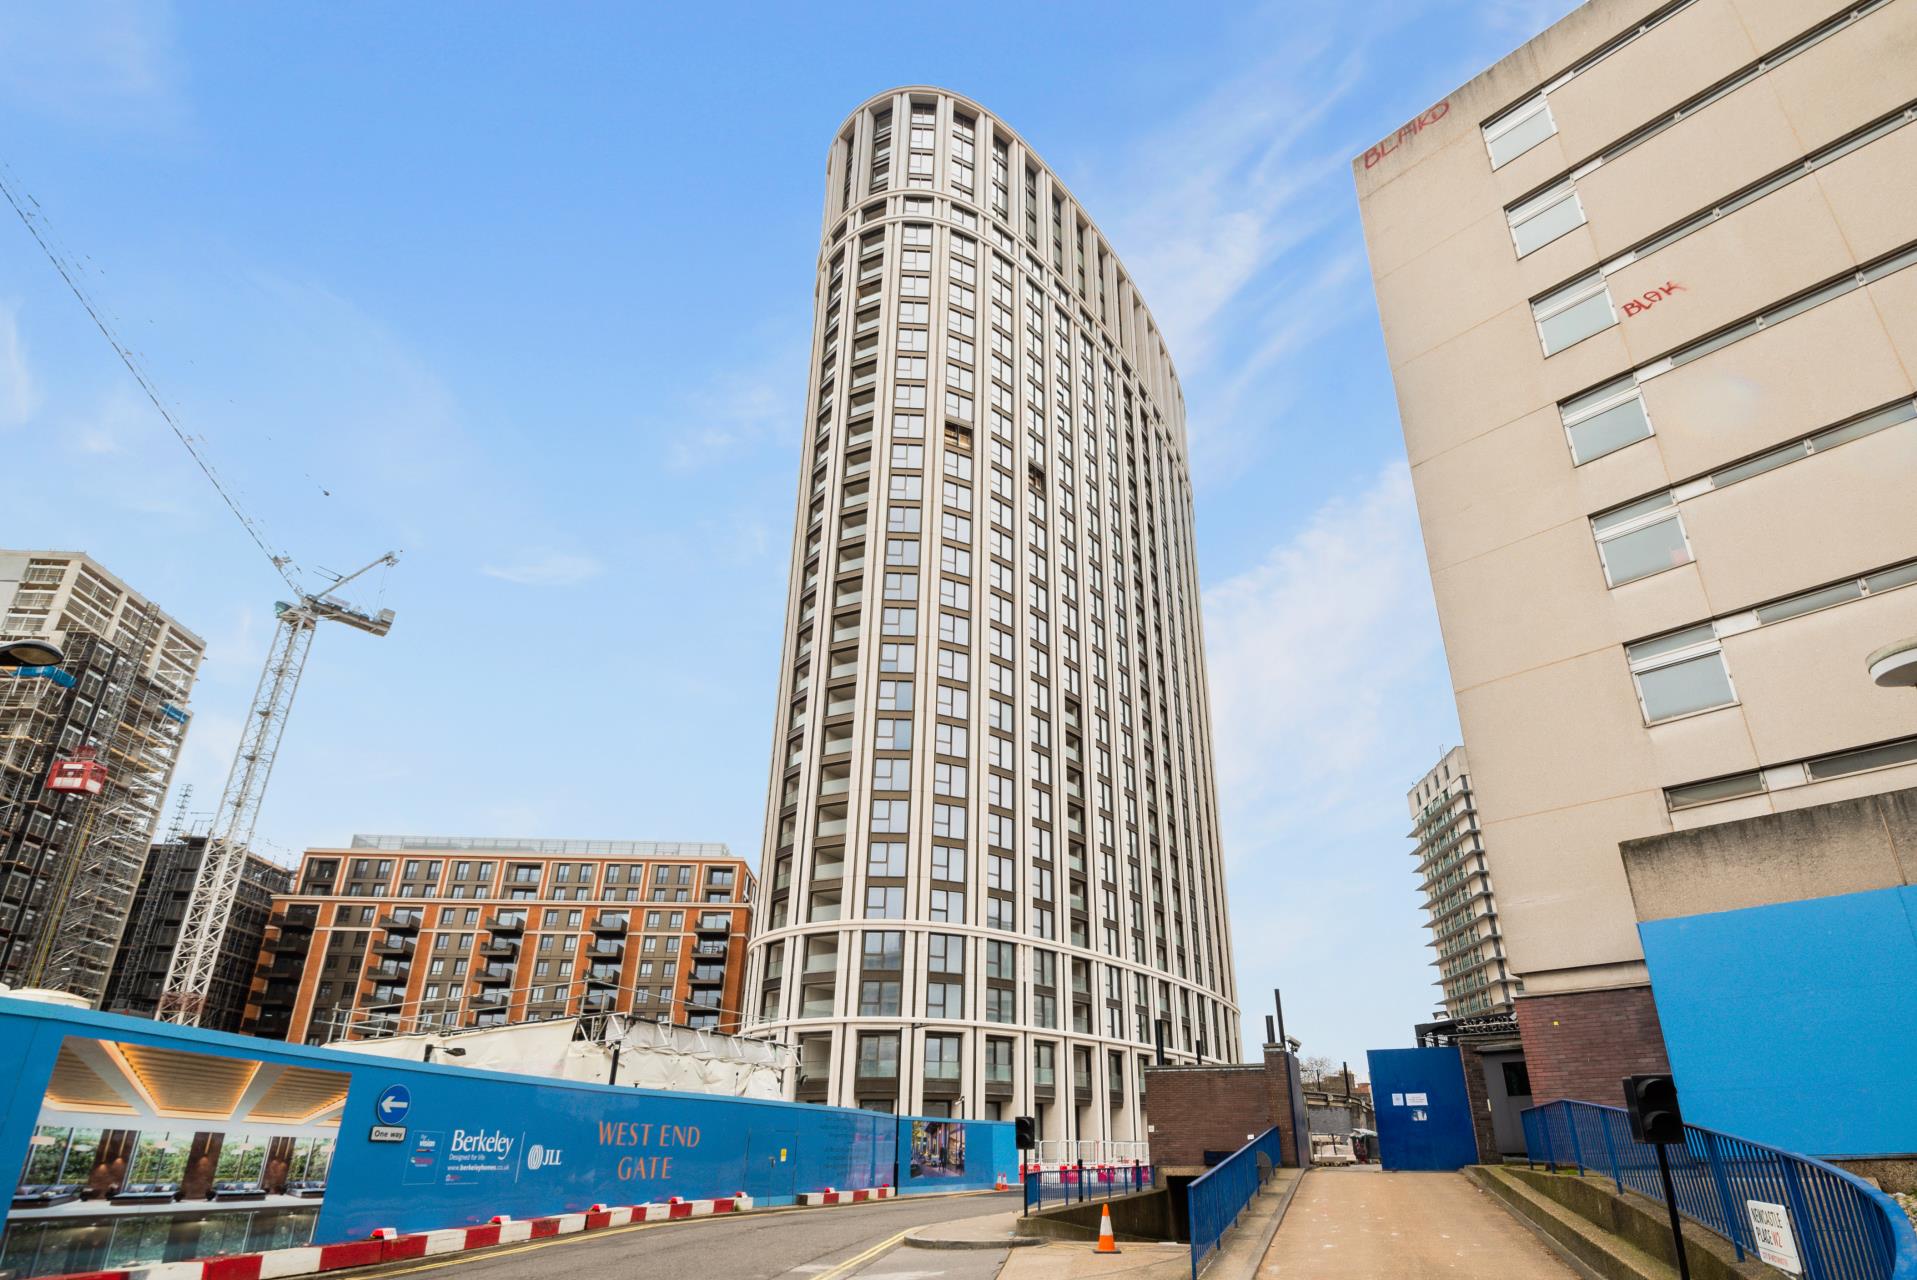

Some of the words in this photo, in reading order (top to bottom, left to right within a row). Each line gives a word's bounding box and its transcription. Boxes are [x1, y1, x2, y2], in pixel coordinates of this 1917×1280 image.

[374, 1129, 388, 1138] One
[390, 1131, 403, 1140] way
[450, 1129, 514, 1160] Berkeley
[599, 1120, 654, 1146] WEST
[660, 1124, 701, 1148] END
[542, 1149, 562, 1166] JLL
[618, 1156, 673, 1180] GATE
[1751, 1207, 1783, 1229] NEWCASTLE
[1755, 1226, 1774, 1245] PLACE
